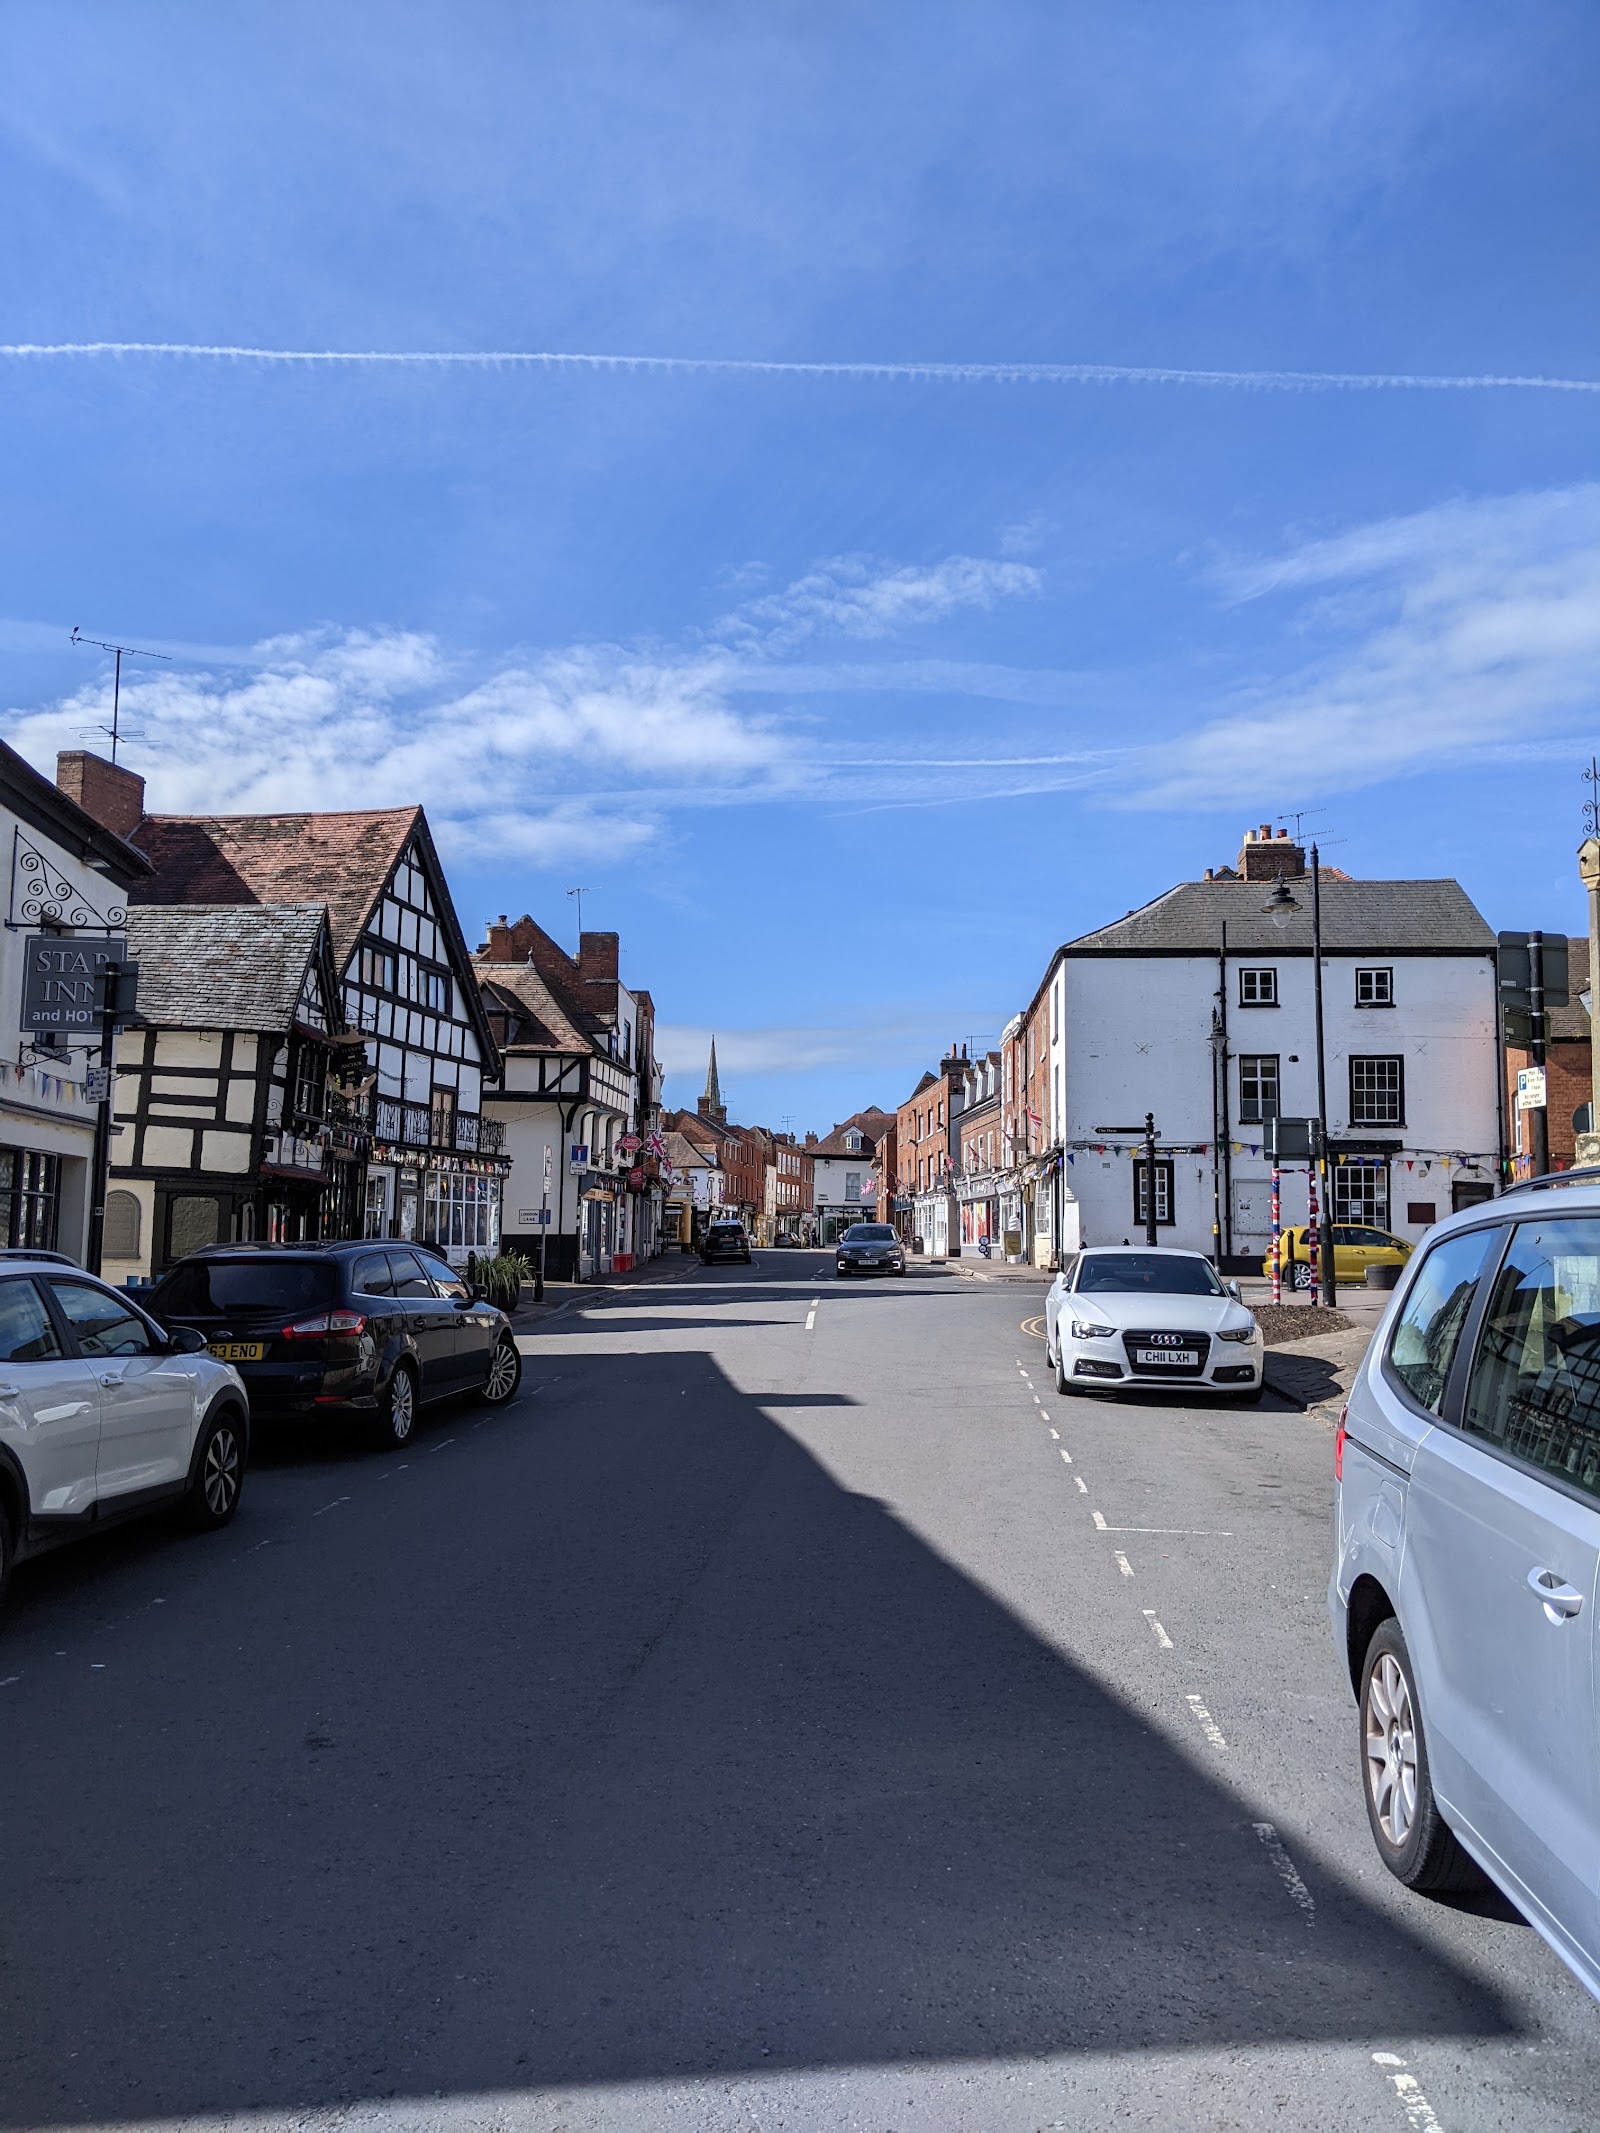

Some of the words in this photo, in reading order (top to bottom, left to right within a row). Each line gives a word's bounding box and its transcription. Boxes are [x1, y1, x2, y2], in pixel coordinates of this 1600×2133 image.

[41, 980, 94, 1003] INN
[32, 1009, 60, 1021] and
[230, 1345, 258, 1358] ENO
[1168, 1352, 1190, 1363] LXH
